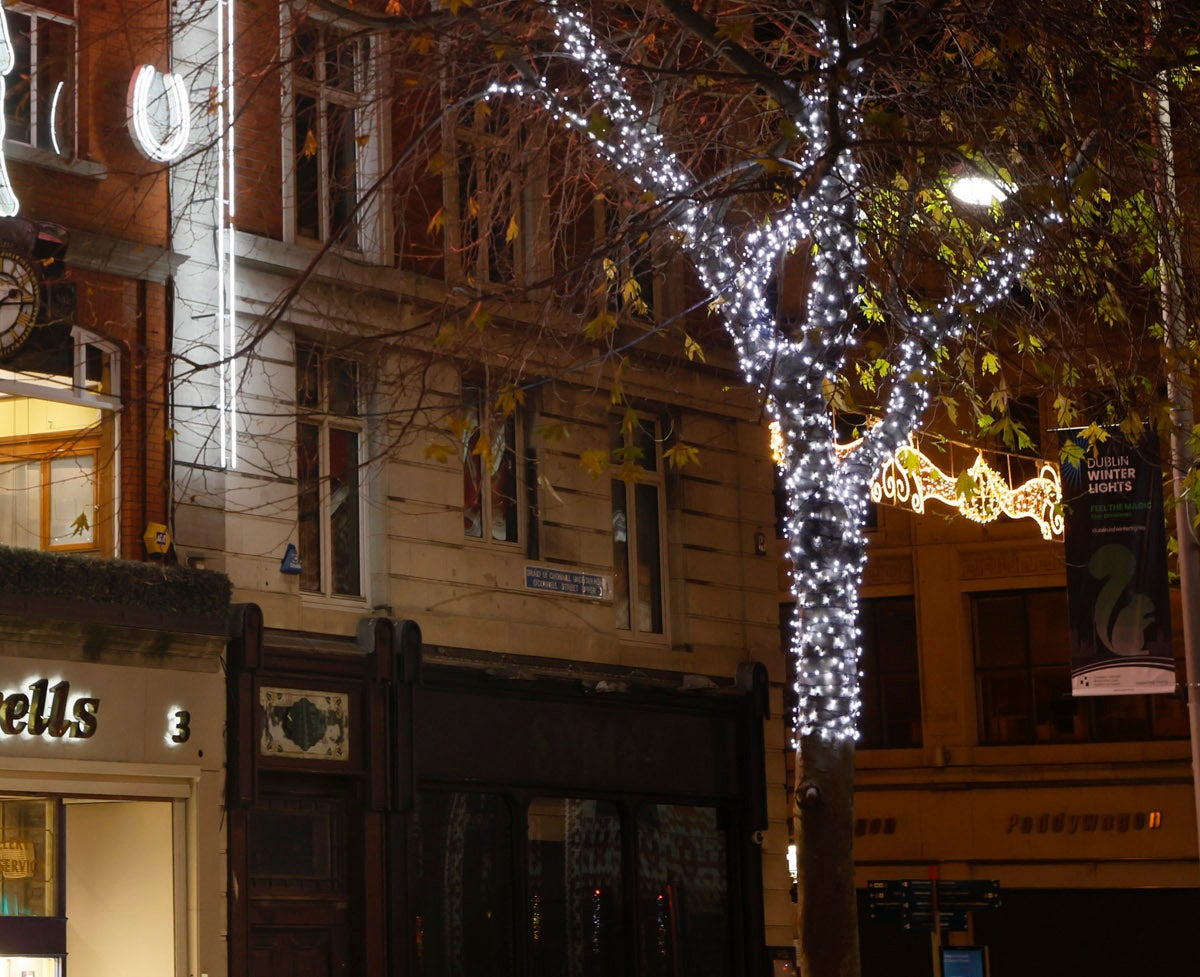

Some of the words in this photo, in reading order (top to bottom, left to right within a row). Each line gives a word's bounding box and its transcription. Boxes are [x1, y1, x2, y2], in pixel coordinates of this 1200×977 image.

[1087, 455, 1129, 469] DUBLIN
[1087, 469, 1135, 480] WINTER
[1088, 481, 1132, 493] LIGHTS
[171, 710, 192, 744] 3
